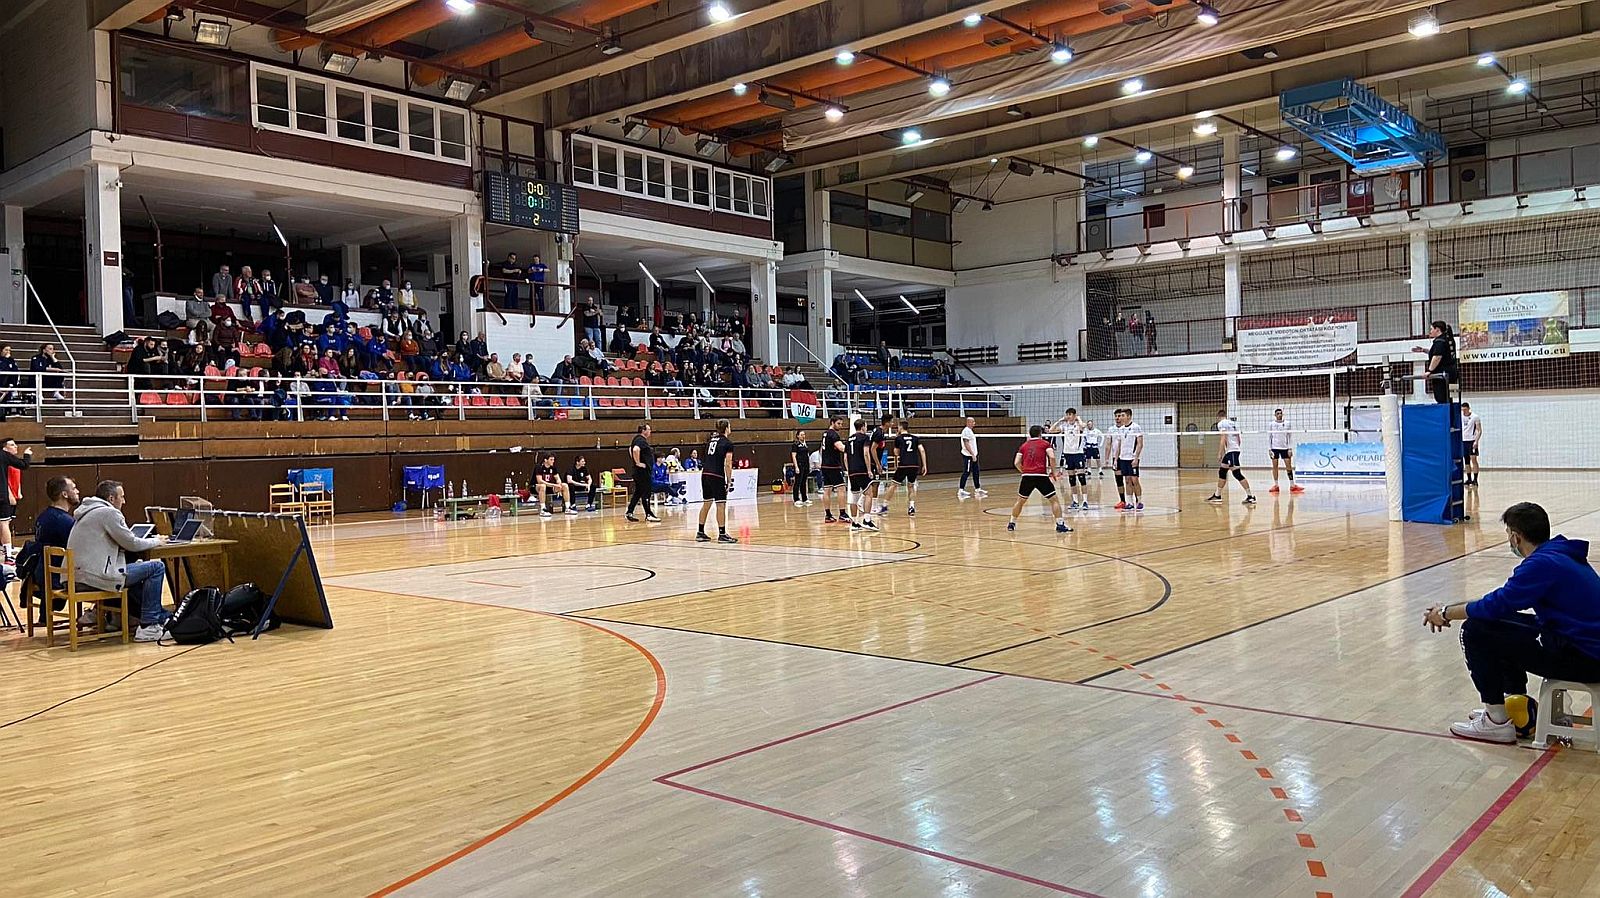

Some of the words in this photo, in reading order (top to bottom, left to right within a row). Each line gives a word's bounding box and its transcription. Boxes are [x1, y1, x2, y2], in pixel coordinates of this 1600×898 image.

[533, 213, 540, 226] 2
[1463, 346, 1566, 360] www.arpadfurdo.eu
[707, 441, 718, 456] 19
[849, 440, 854, 455] 1
[905, 440, 913, 452] 2
